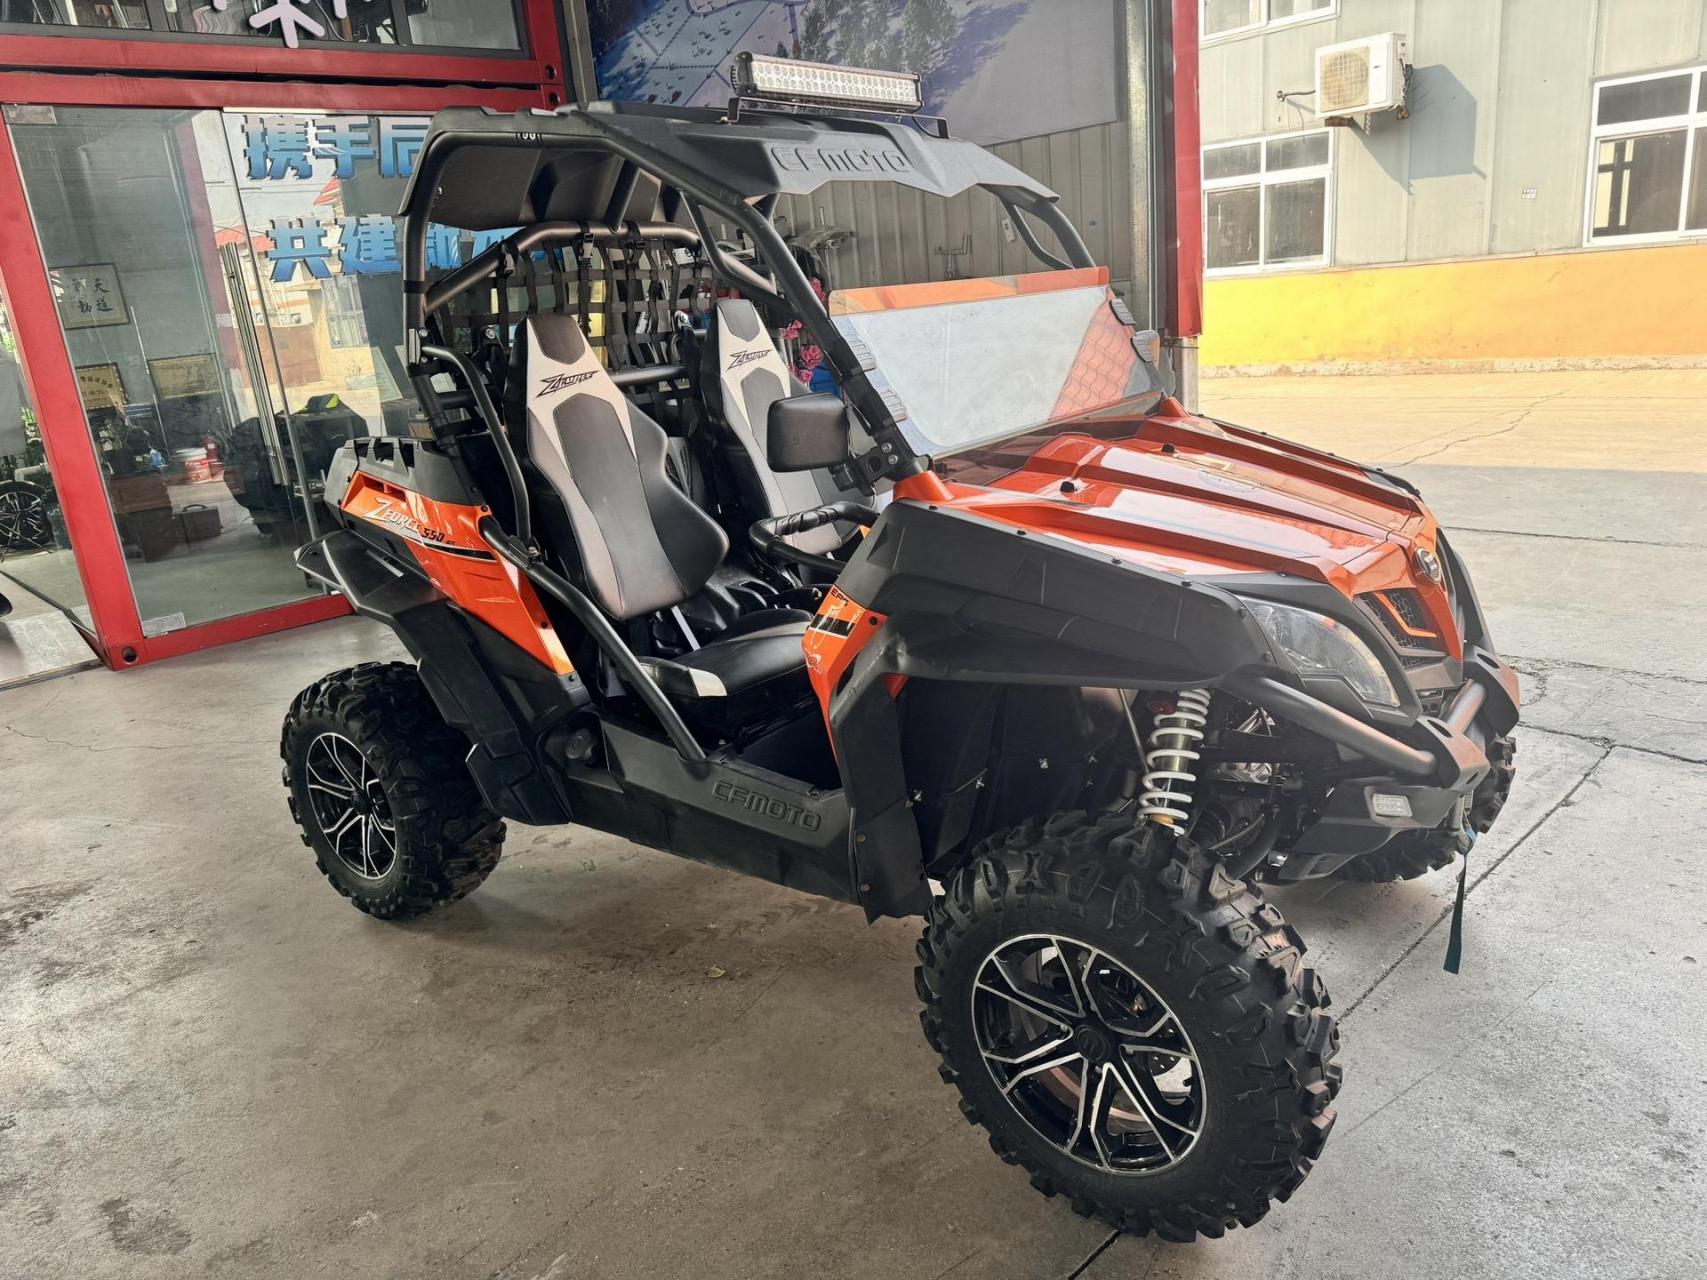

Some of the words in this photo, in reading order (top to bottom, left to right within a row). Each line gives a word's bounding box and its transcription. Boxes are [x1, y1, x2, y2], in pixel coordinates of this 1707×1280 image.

[770, 146, 911, 173] CFMOTO
[421, 527, 446, 543] 550
[711, 780, 823, 833] CFMOTO
